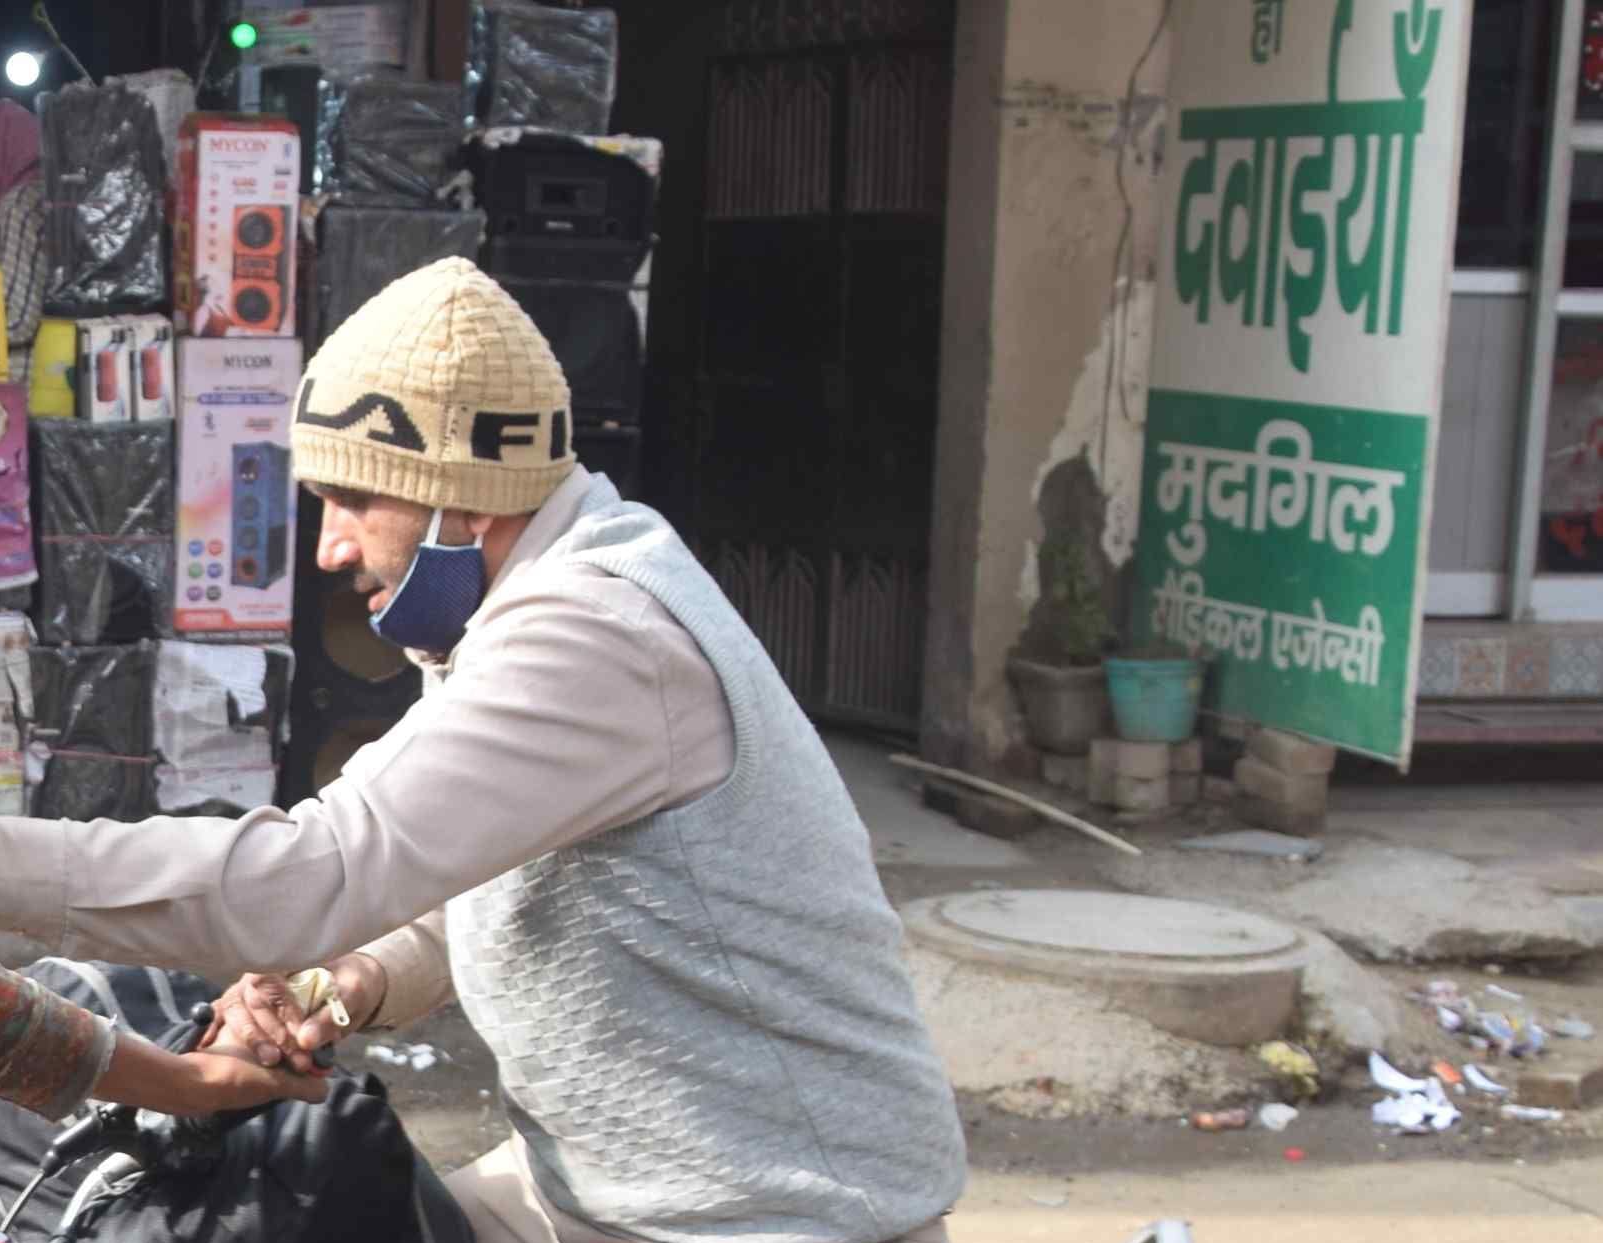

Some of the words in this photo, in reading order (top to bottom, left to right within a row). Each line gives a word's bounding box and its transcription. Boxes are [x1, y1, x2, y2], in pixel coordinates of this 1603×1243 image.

[209, 138, 268, 153] MYCON
[223, 354, 274, 369] MYCON
[1157, 419, 1406, 566] मुदगिल
[1271, 597, 1385, 687] एजेन्सी
